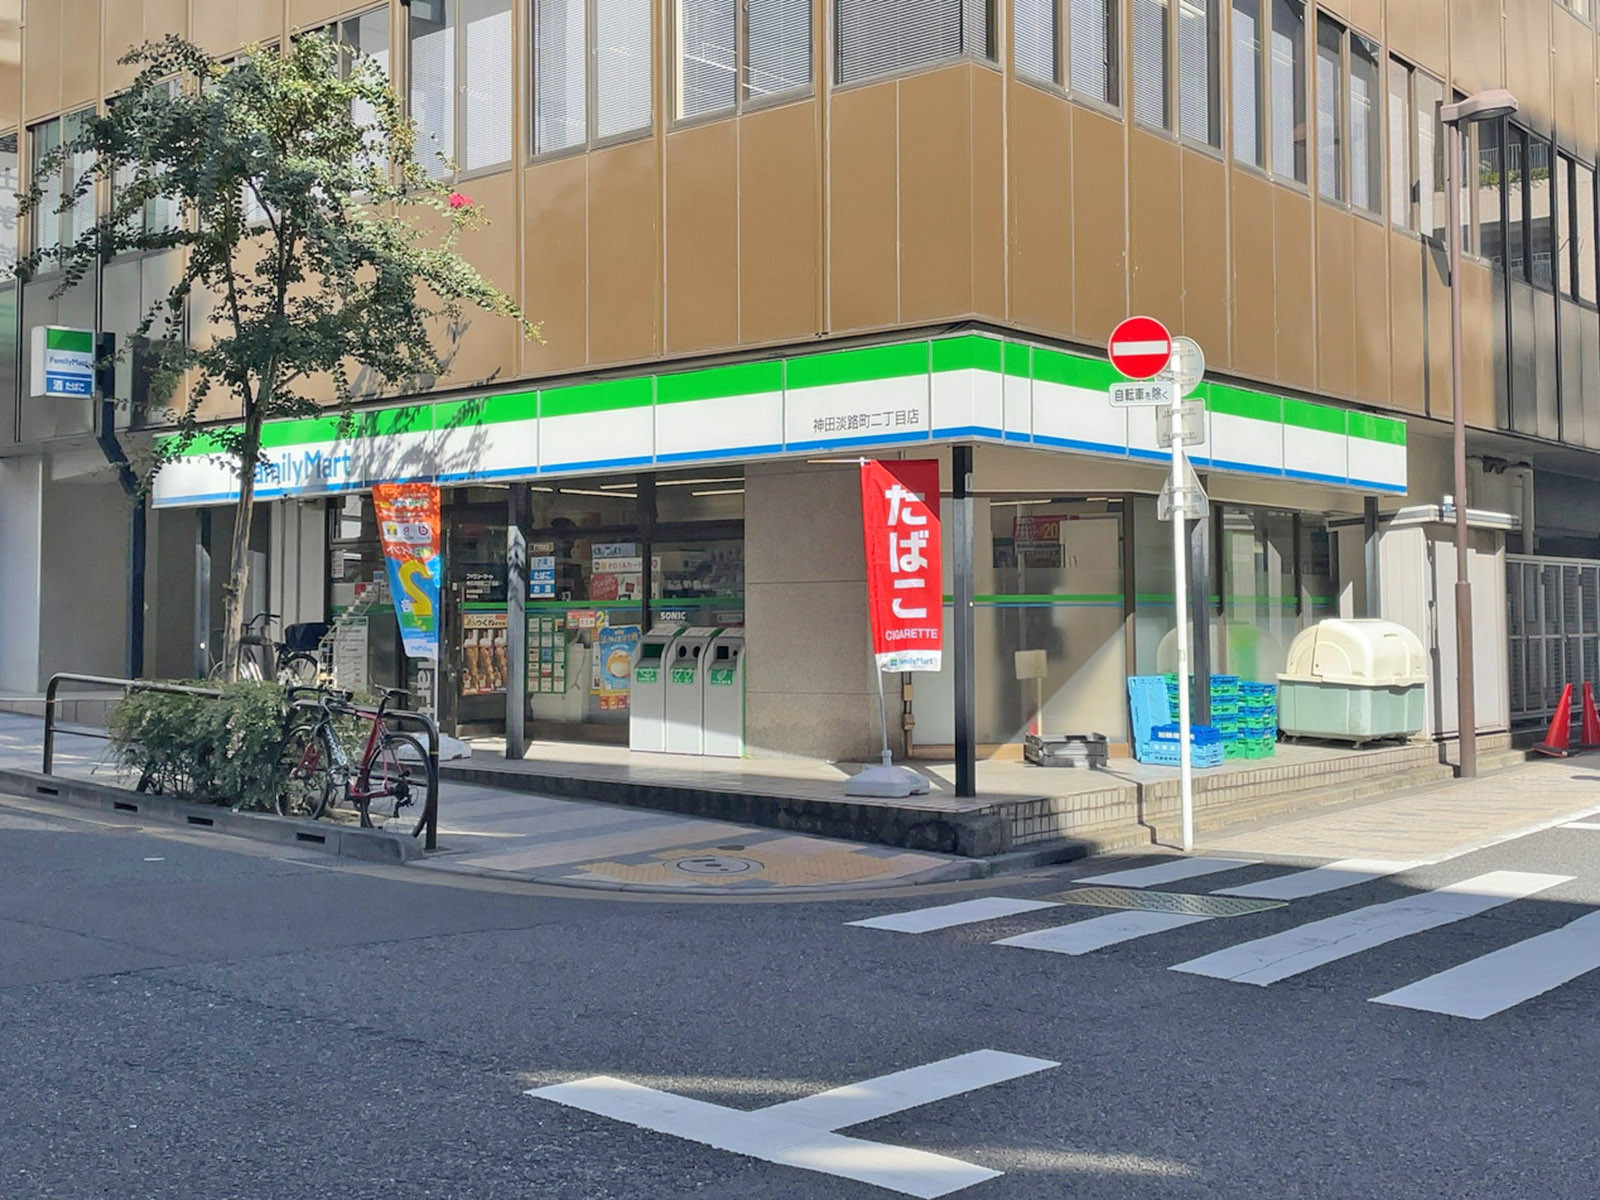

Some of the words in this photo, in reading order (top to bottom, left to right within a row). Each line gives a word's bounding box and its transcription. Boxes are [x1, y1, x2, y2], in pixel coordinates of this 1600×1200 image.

[1115, 387, 1168, 402] 自転車を除く
[813, 409, 919, 432] 神田淡路町二丁目店
[254, 450, 351, 485] amilyMart
[885, 484, 929, 618] たばこ
[660, 611, 687, 620] SONIC
[885, 628, 938, 641] CIGARETTE
